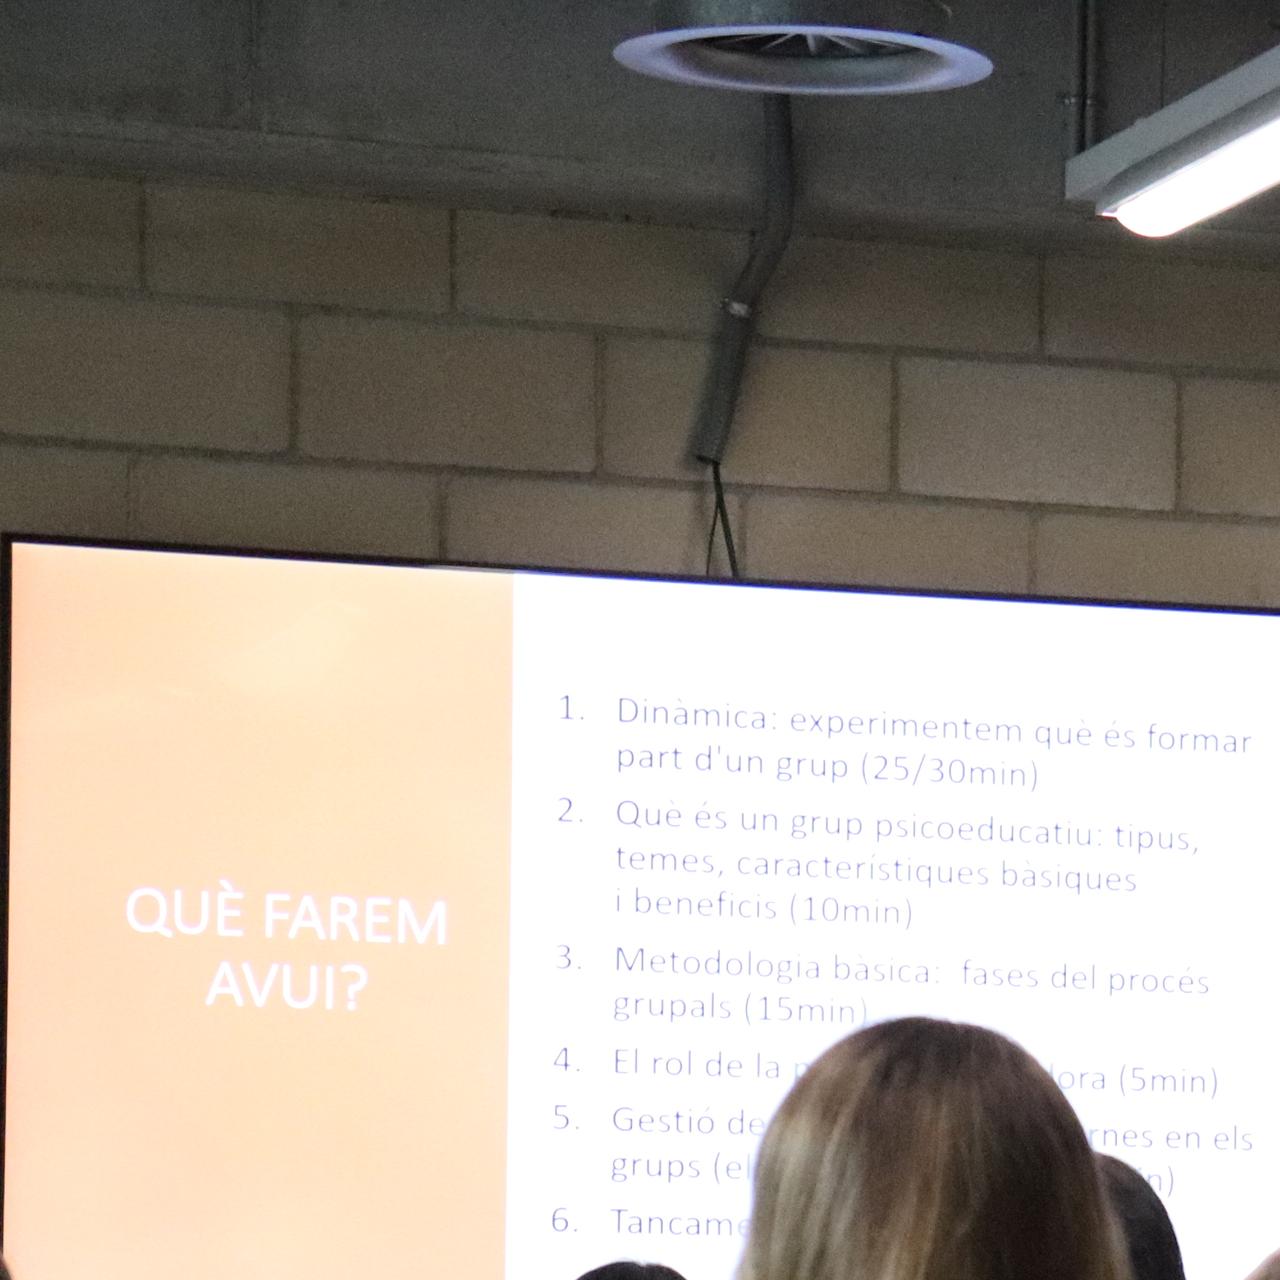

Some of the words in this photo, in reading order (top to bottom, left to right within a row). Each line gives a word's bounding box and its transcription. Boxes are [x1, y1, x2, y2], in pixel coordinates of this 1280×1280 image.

[559, 695, 585, 721] 1.
[618, 697, 777, 731] Dinàmica:
[790, 711, 1023, 741] experimentem
[1035, 719, 1092, 750] què
[1104, 720, 1136, 748] és
[1148, 723, 1252, 753] formar
[617, 747, 682, 773] part
[694, 745, 763, 774] d'un
[776, 756, 848, 783] grup
[861, 752, 1038, 792] (25/30min)
[557, 797, 585, 824] 2.
[616, 799, 682, 829] Què
[694, 801, 728, 830] és
[740, 811, 778, 832] un
[791, 814, 863, 841] grup
[876, 814, 1102, 846] psicoeducatiu:
[1115, 824, 1199, 855] tipus,
[616, 847, 724, 878] temes,
[737, 854, 989, 888] característiques
[1002, 860, 1137, 895] bàsiques
[126, 878, 245, 939] QUÈ
[264, 892, 448, 945] FAREM
[634, 887, 777, 919] beneficis
[790, 893, 913, 930] (10min)
[205, 961, 368, 1011] AVUI?
[555, 944, 583, 970] 3.
[616, 946, 821, 984] Metodologia
[834, 953, 940, 983] bàsica:
[963, 959, 1039, 988] fases
[1051, 964, 1096, 990] del
[1109, 966, 1210, 996] procés
[613, 992, 732, 1022] grupals
[745, 993, 867, 1026] (15min)
[553, 1047, 582, 1072] 4.
[615, 1048, 639, 1074] El
[653, 1050, 692, 1075] rol
[706, 1051, 743, 1077] de
[756, 1053, 780, 1078] la
[1120, 1064, 1218, 1100] (5min)
[553, 1104, 580, 1130] 5.
[612, 1106, 715, 1135] Gestió
[1166, 1129, 1201, 1150] en
[1213, 1125, 1253, 1151] els
[610, 1153, 701, 1184] grups
[552, 1207, 578, 1233] 6.
